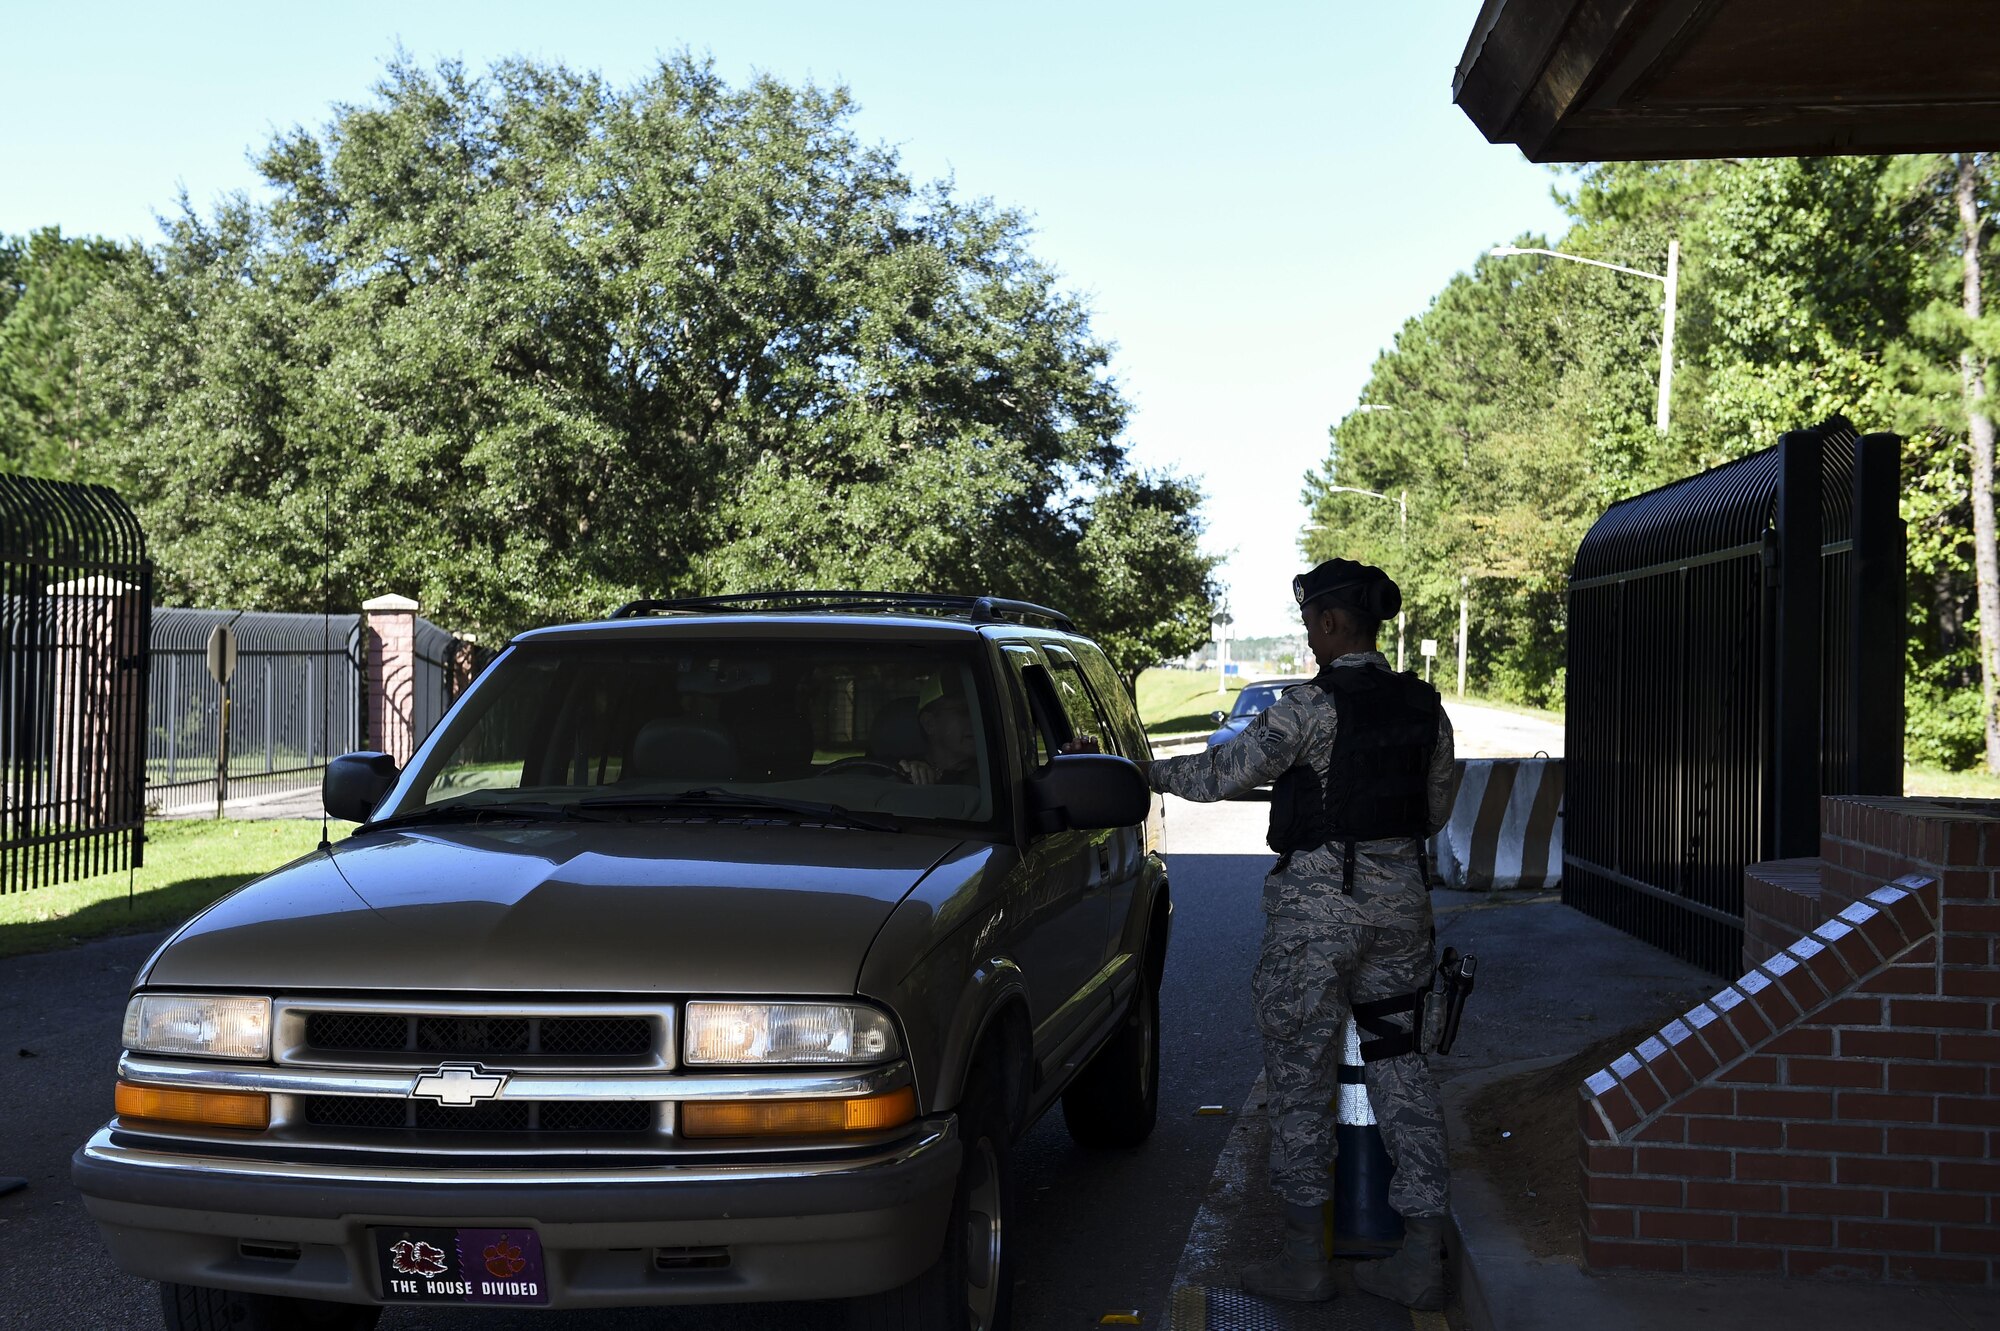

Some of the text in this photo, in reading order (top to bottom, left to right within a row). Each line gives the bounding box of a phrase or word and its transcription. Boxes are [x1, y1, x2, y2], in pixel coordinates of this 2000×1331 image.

[391, 1280, 538, 1296] THE HOUSE DIVIDED
